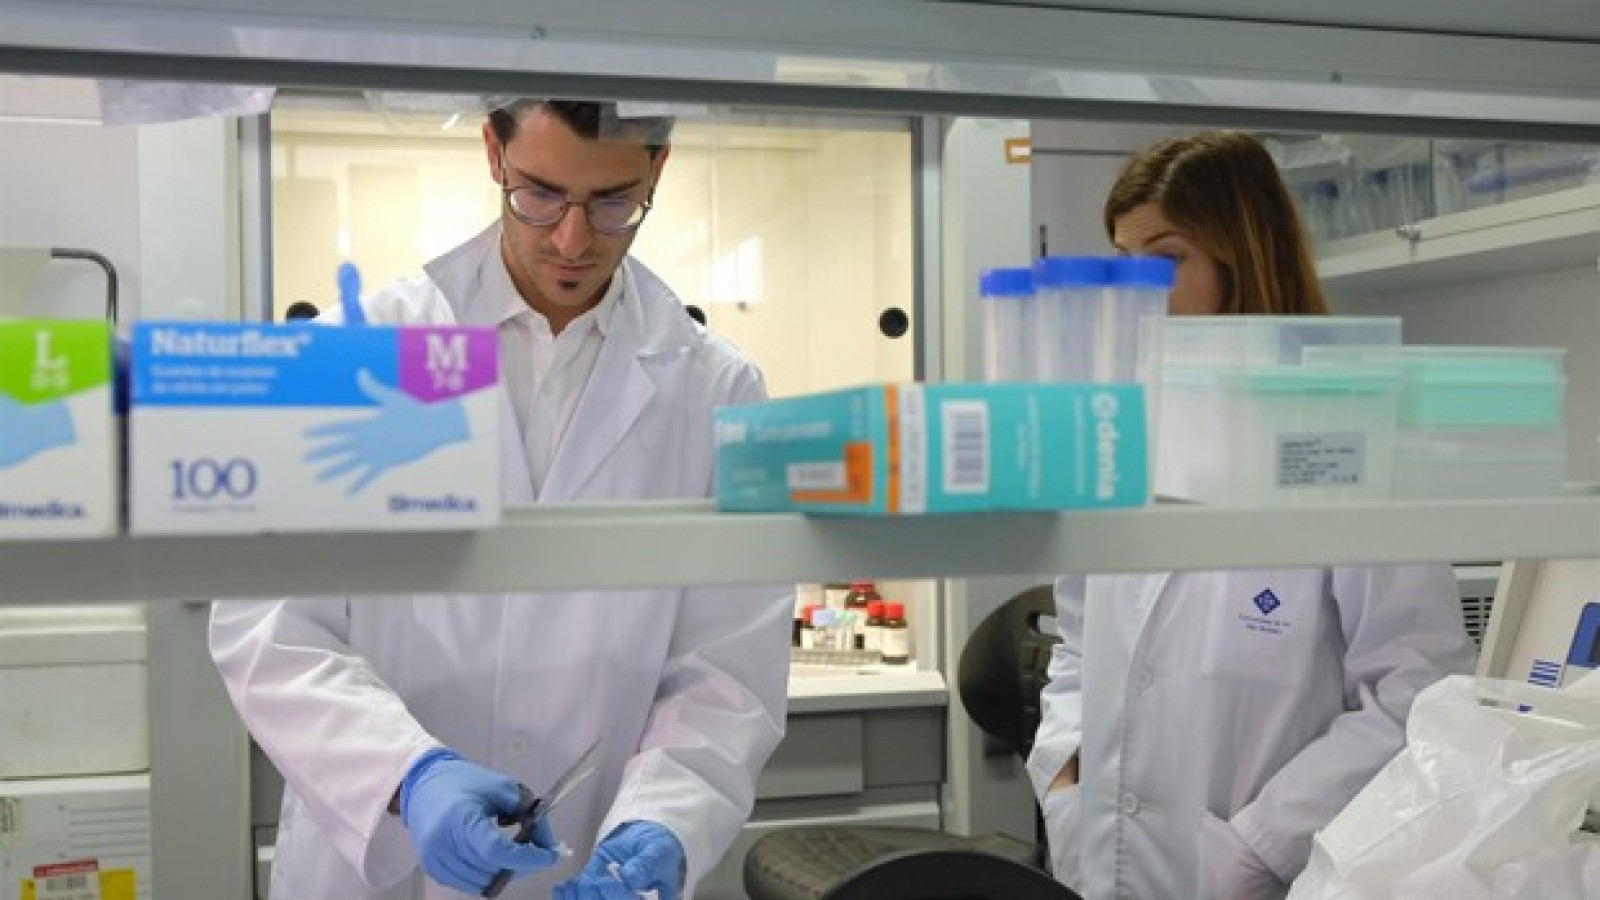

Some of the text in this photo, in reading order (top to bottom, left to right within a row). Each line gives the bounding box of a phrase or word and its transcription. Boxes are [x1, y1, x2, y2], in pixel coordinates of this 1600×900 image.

[34, 330, 68, 369] L
[425, 334, 468, 371] M
[169, 456, 257, 500] 100
